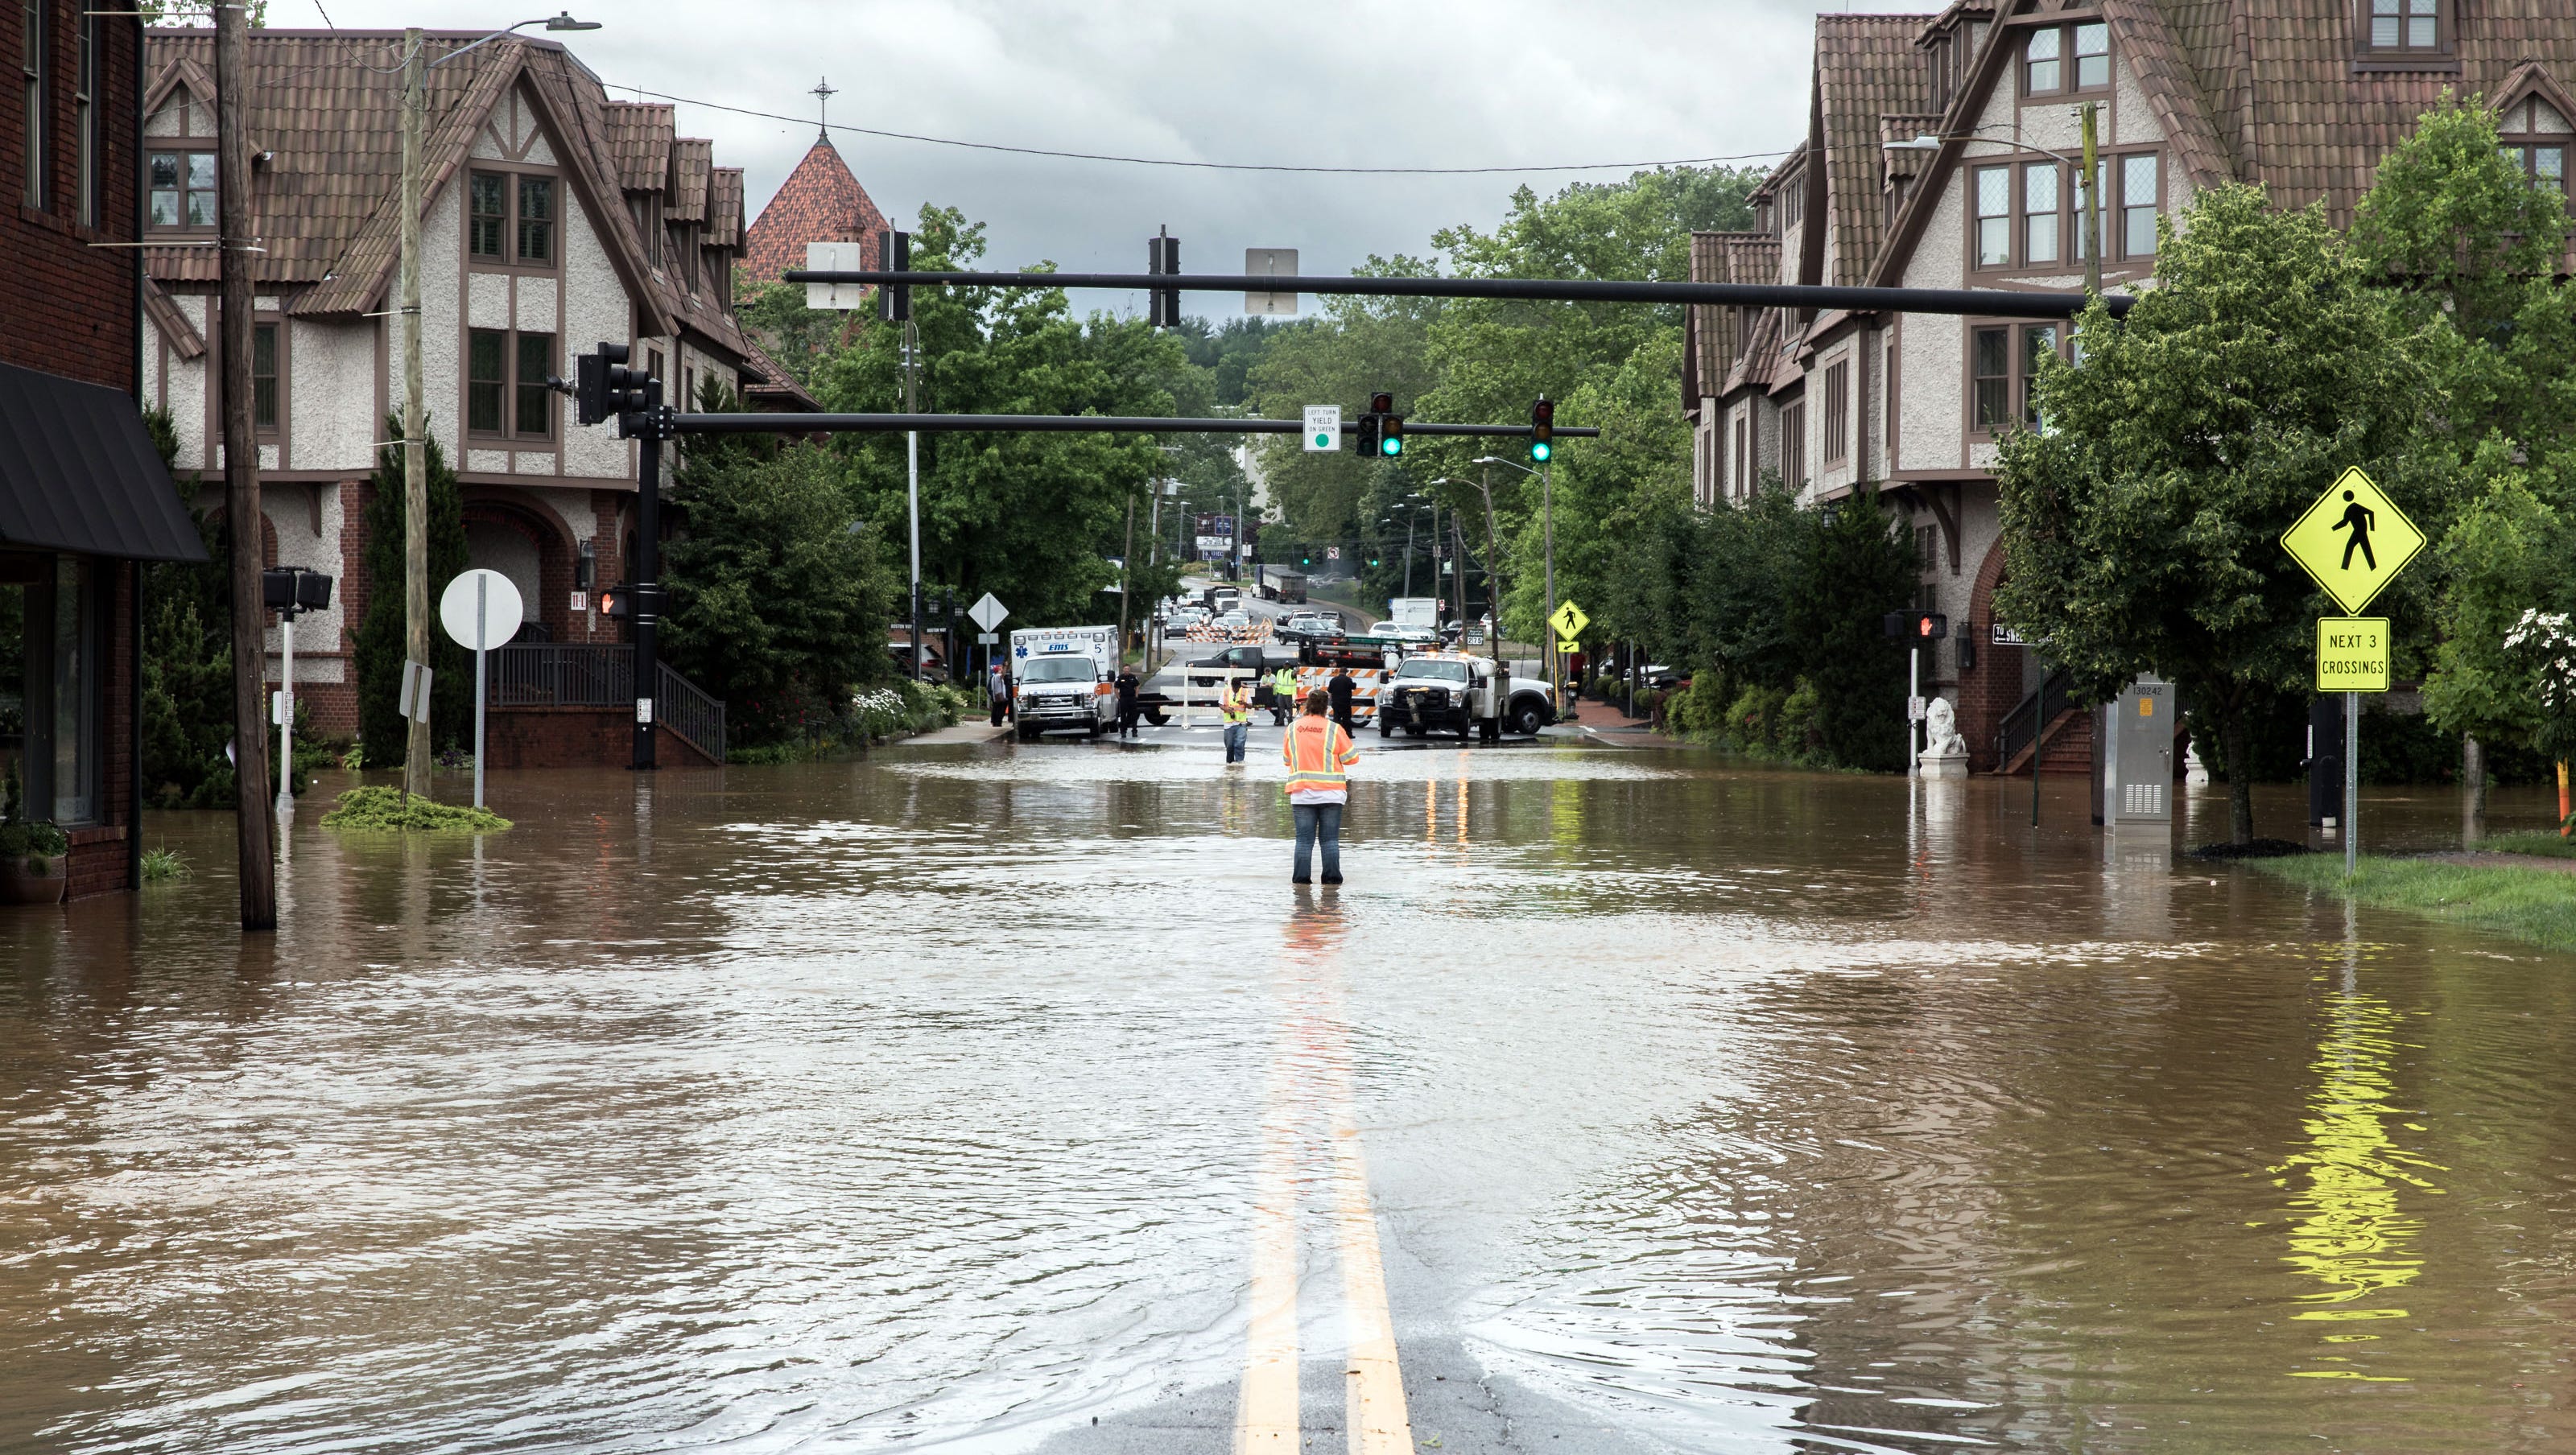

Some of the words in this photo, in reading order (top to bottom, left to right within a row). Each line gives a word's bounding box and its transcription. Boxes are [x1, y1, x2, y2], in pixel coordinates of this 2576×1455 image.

[1996, 626, 2004, 635] TO
[2330, 634, 2362, 648] NEXT
[2369, 634, 2376, 648] 3
[1094, 644, 1102, 653] 5
[2322, 661, 2384, 674] CROSSINGS
[2133, 686, 2162, 695] 130242
